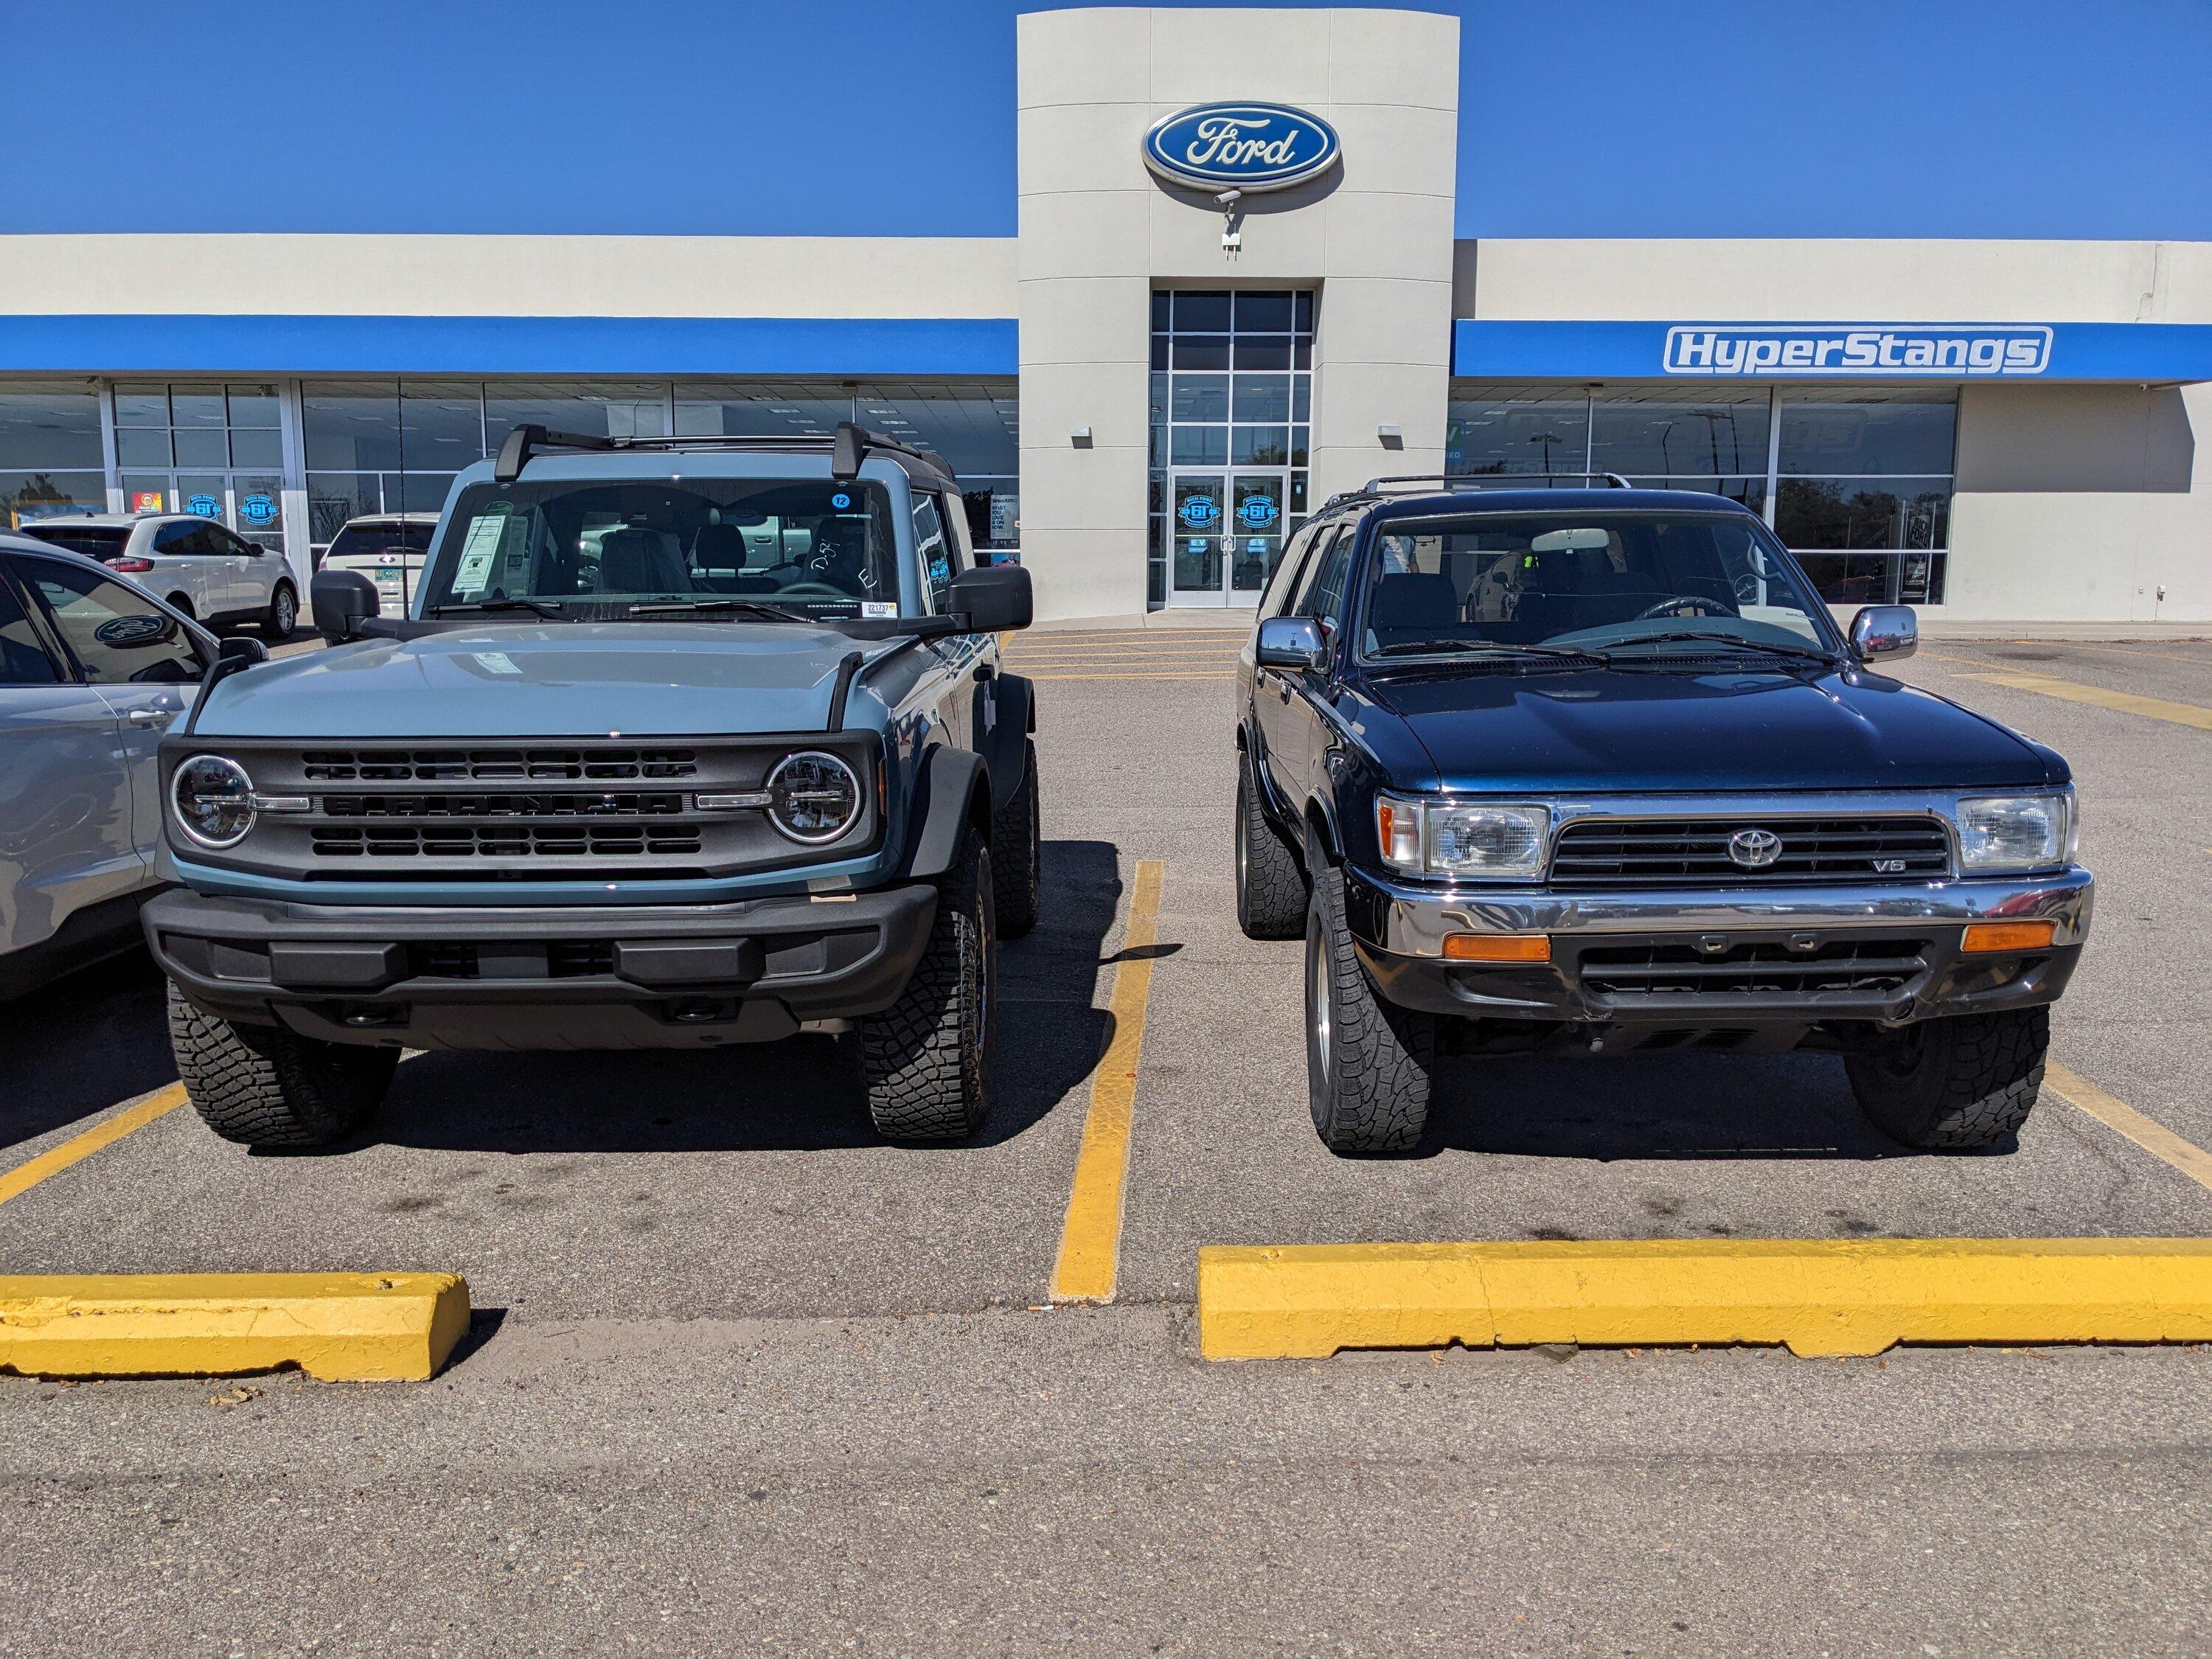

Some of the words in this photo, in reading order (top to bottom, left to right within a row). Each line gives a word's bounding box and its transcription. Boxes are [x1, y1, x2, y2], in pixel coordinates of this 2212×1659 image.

[1186, 116, 1299, 165] Ford
[1676, 333, 2041, 373] HyperStangs
[835, 496, 846, 505] 12
[1872, 859, 1907, 872] V6
